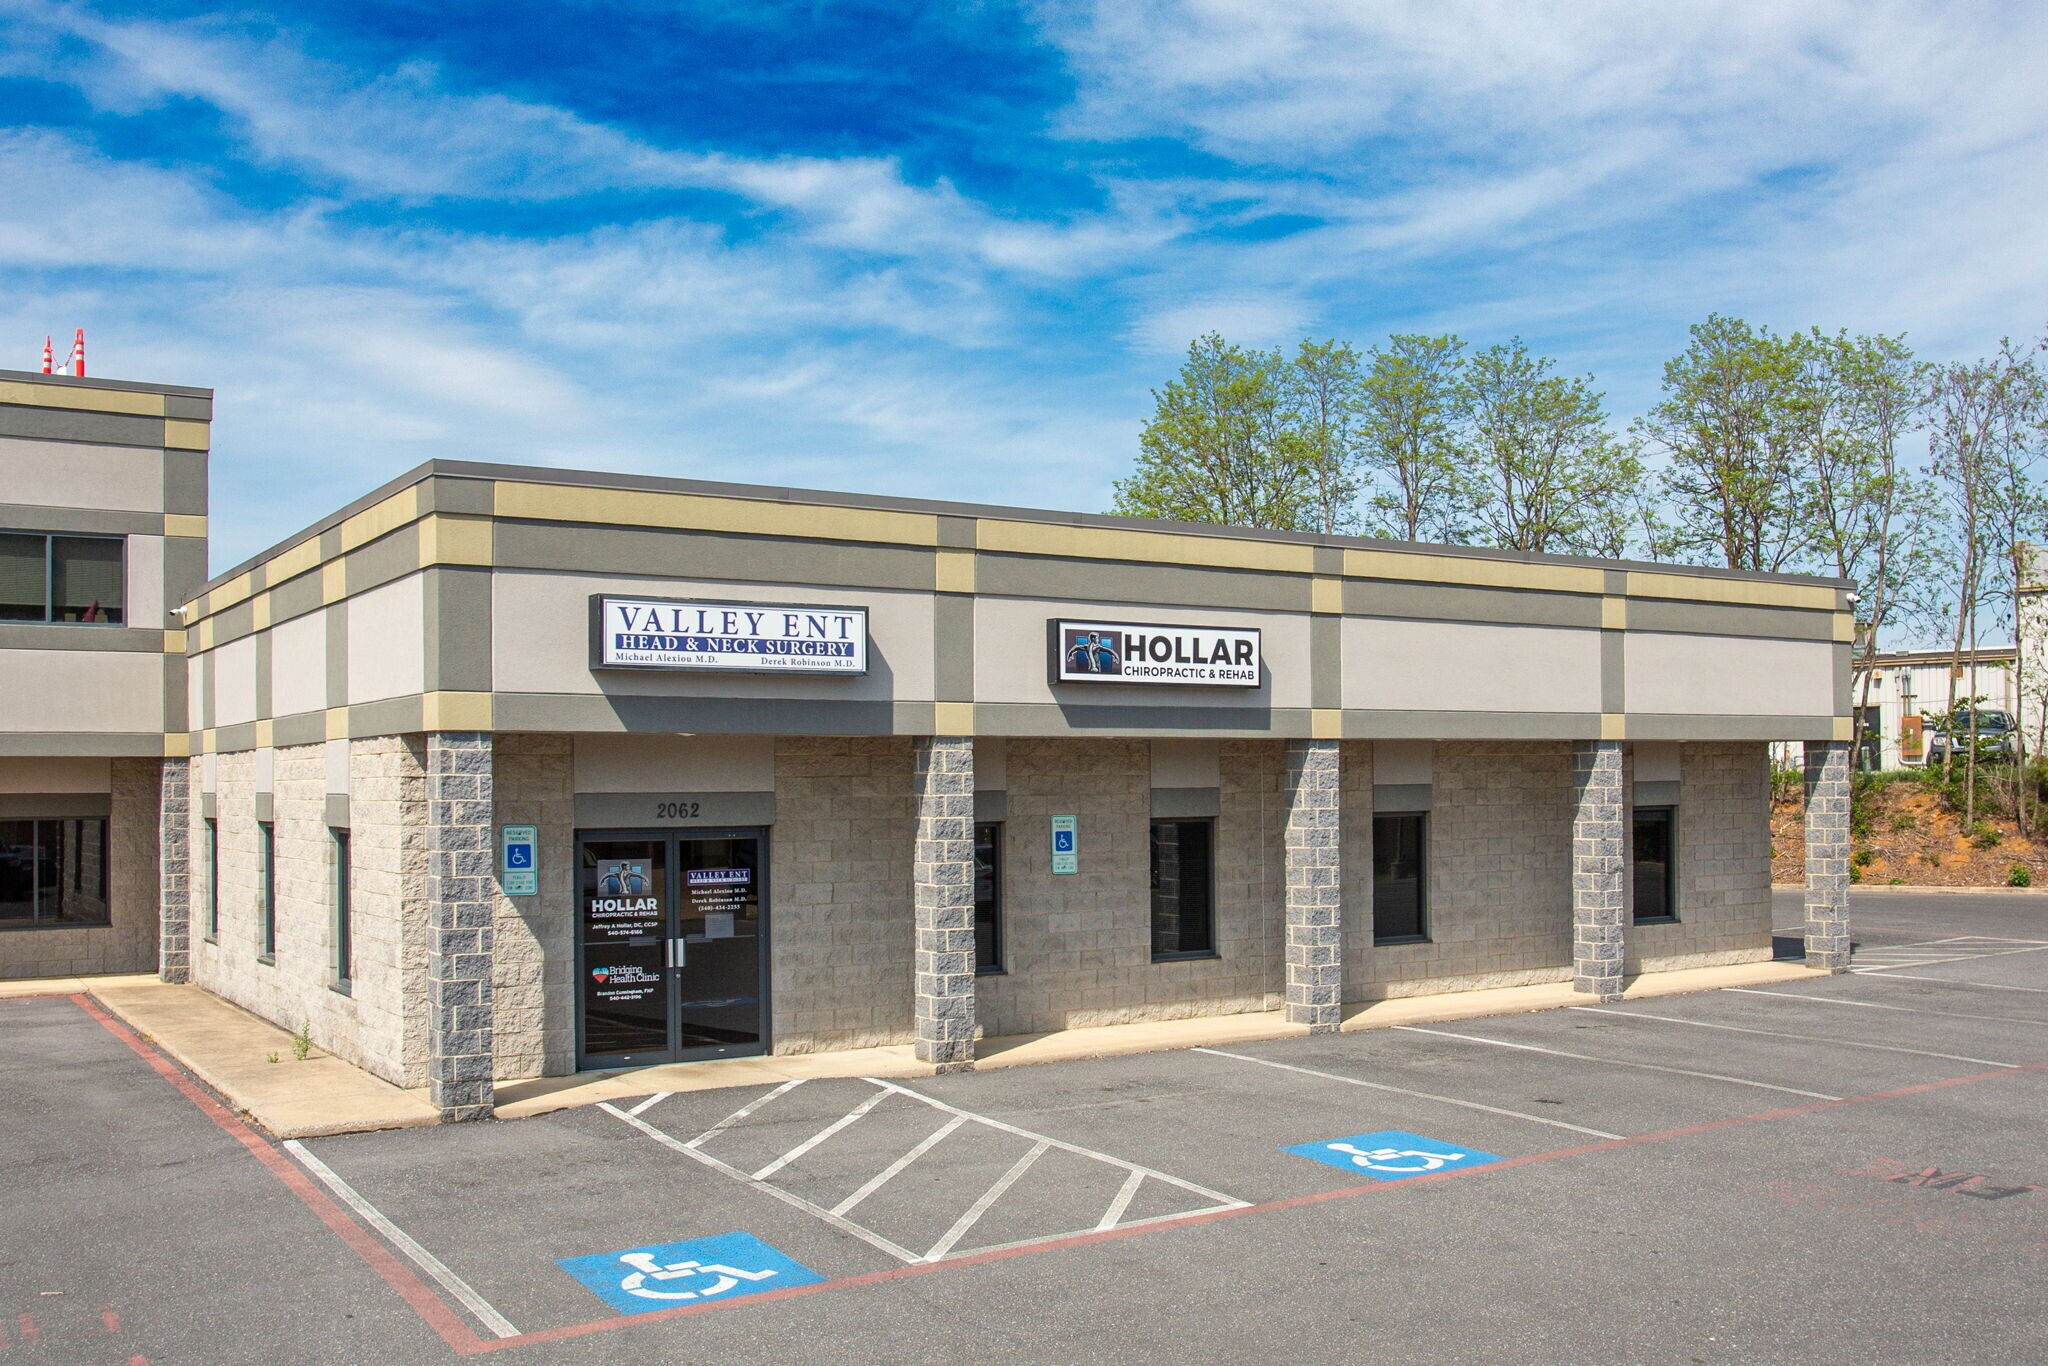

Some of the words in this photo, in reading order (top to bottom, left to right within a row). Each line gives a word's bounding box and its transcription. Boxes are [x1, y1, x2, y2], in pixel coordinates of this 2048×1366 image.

[618, 606, 766, 637] VALLEY
[783, 613, 853, 640] ENT
[621, 635, 678, 651] HEAD
[686, 637, 699, 651] &
[707, 638, 759, 653] NECK
[766, 641, 849, 656] SURGERY
[1124, 634, 1254, 666] HOLLAR
[615, 652, 653, 663] Michael
[656, 653, 692, 664] Alexiou
[695, 654, 718, 664] M.D.
[761, 657, 788, 666] Derek
[791, 657, 832, 667] Robinson
[834, 658, 856, 668] M.D.
[1124, 665, 1206, 679] CHIROPRACTIC
[1209, 669, 1216, 679] &
[1219, 669, 1255, 680] REHAB
[656, 802, 700, 819] 2062
[690, 871, 726, 879] VALLEY
[729, 870, 748, 878] ENT
[591, 897, 658, 912] HOLLAR
[609, 964, 643, 976] Bridging
[609, 972, 636, 984] Health
[636, 972, 660, 983] Clinic
